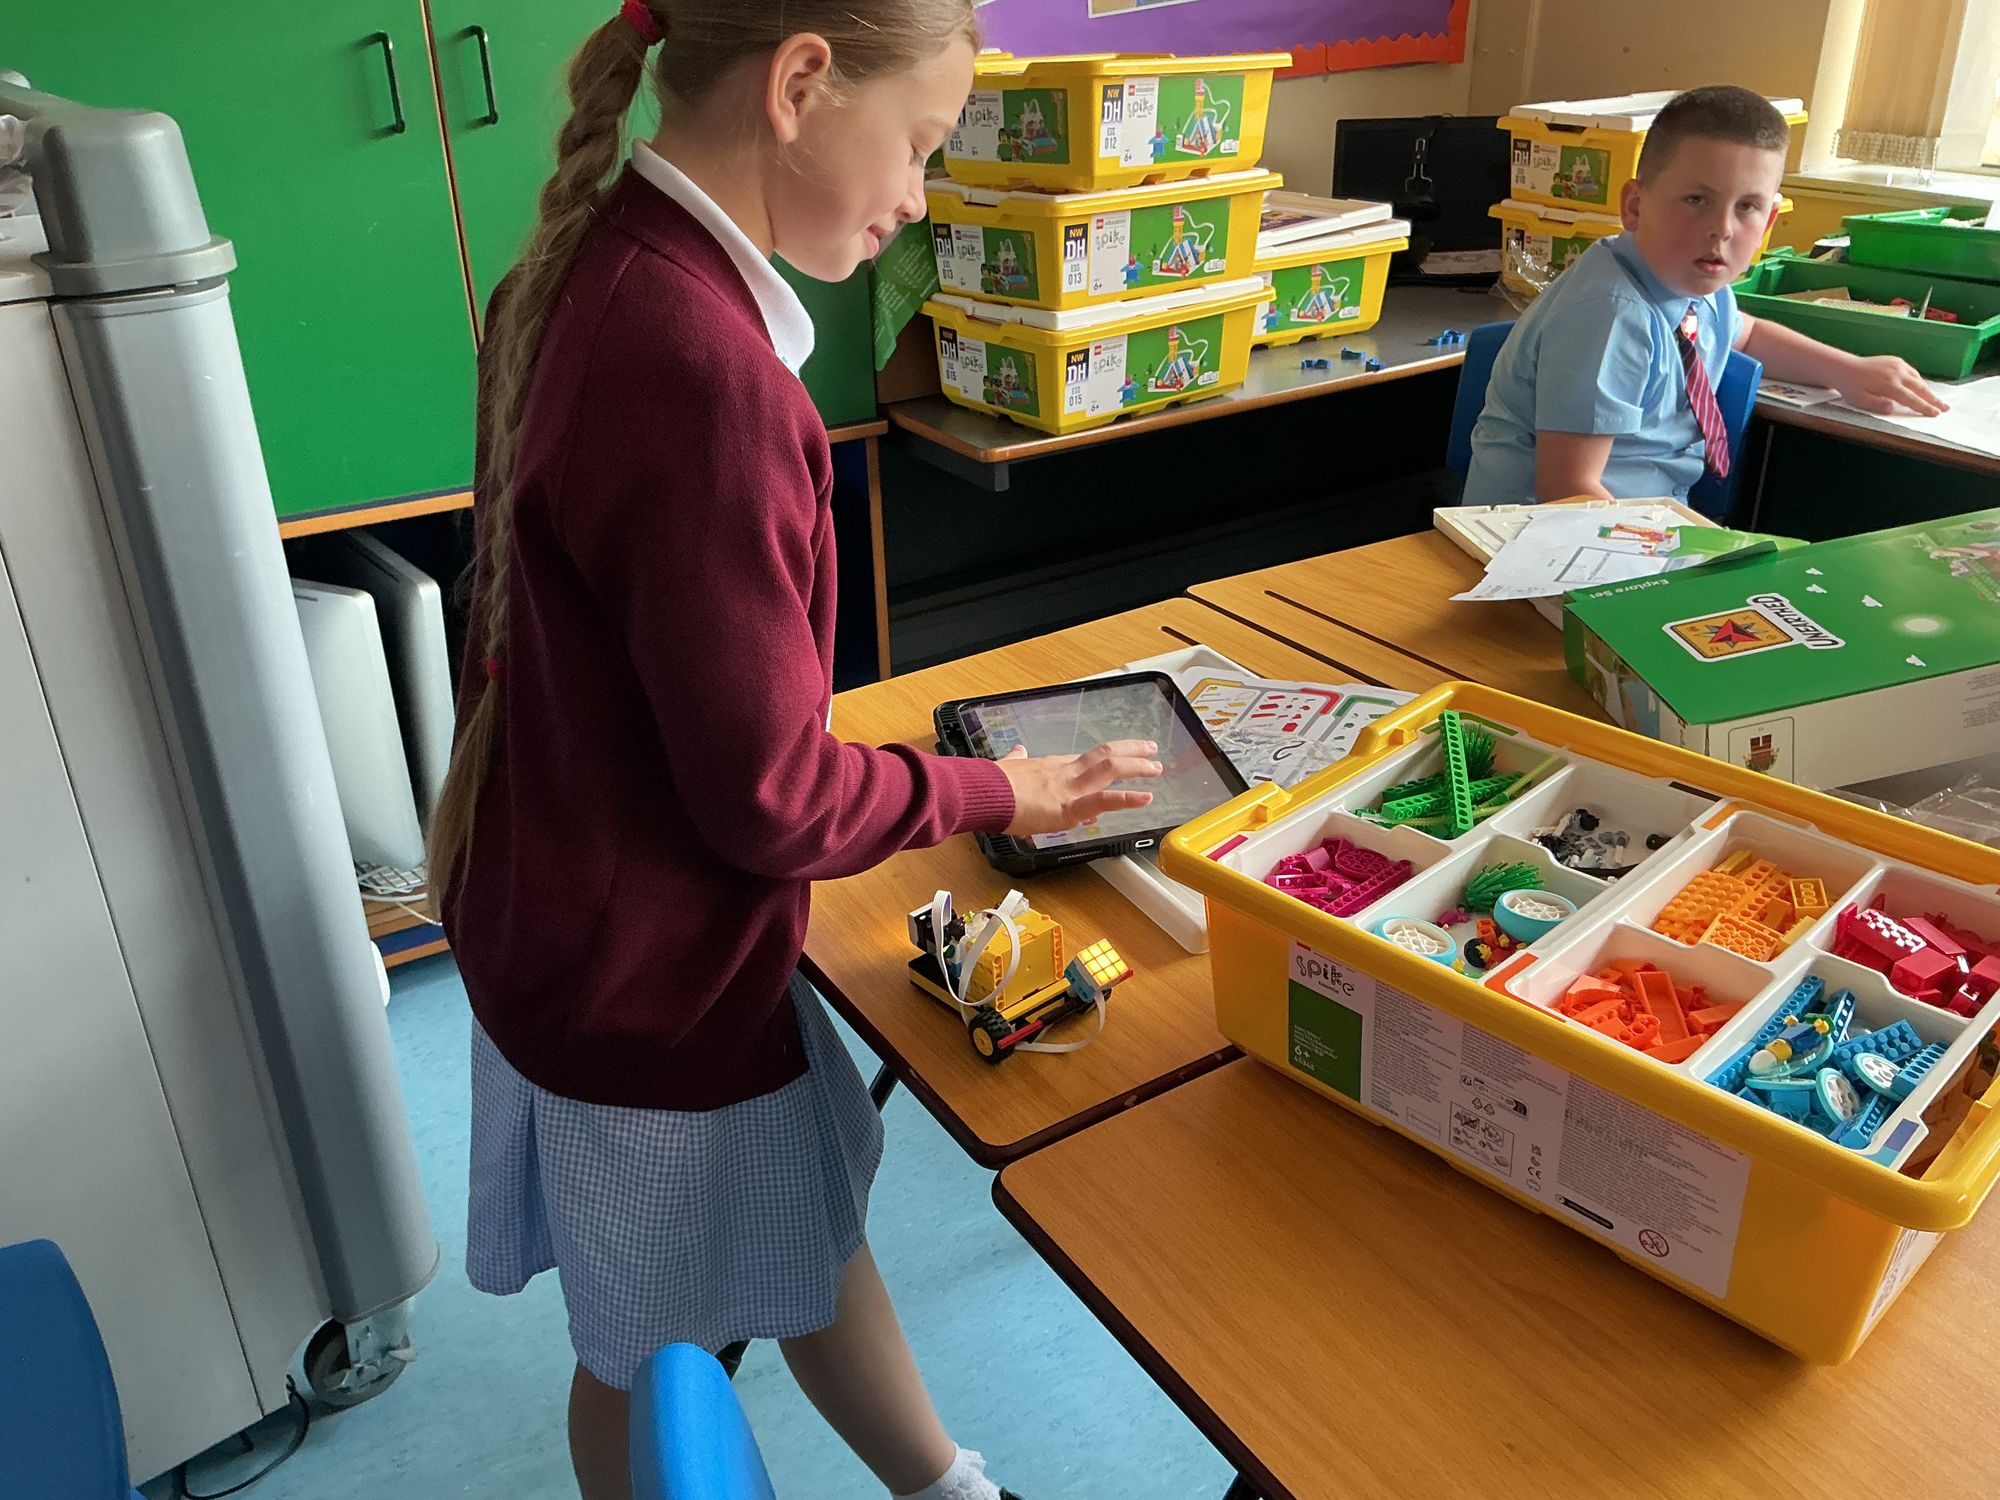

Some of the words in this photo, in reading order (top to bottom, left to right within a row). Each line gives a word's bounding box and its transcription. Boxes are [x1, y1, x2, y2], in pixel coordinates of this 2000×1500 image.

[1107, 88, 1120, 98] NW
[1103, 100, 1121, 123] DH
[1104, 137, 1117, 149] 012
[1513, 149, 1530, 166] DH
[1069, 227, 1084, 238] NW
[935, 237, 954, 257] DH
[1065, 239, 1086, 261] DH
[1070, 263, 1080, 272] ESS
[1067, 272, 1082, 286] 013
[940, 340, 959, 360] DH
[1070, 353, 1085, 364] NW
[1066, 364, 1087, 385] DH
[1071, 386, 1081, 395] ESS
[1069, 395, 1083, 407] 015
[1615, 578, 1669, 593] Explore
[1588, 590, 1613, 599] Set
[1752, 596, 1840, 647] UNEARTHED
[1294, 1045, 1311, 1060] 6+
